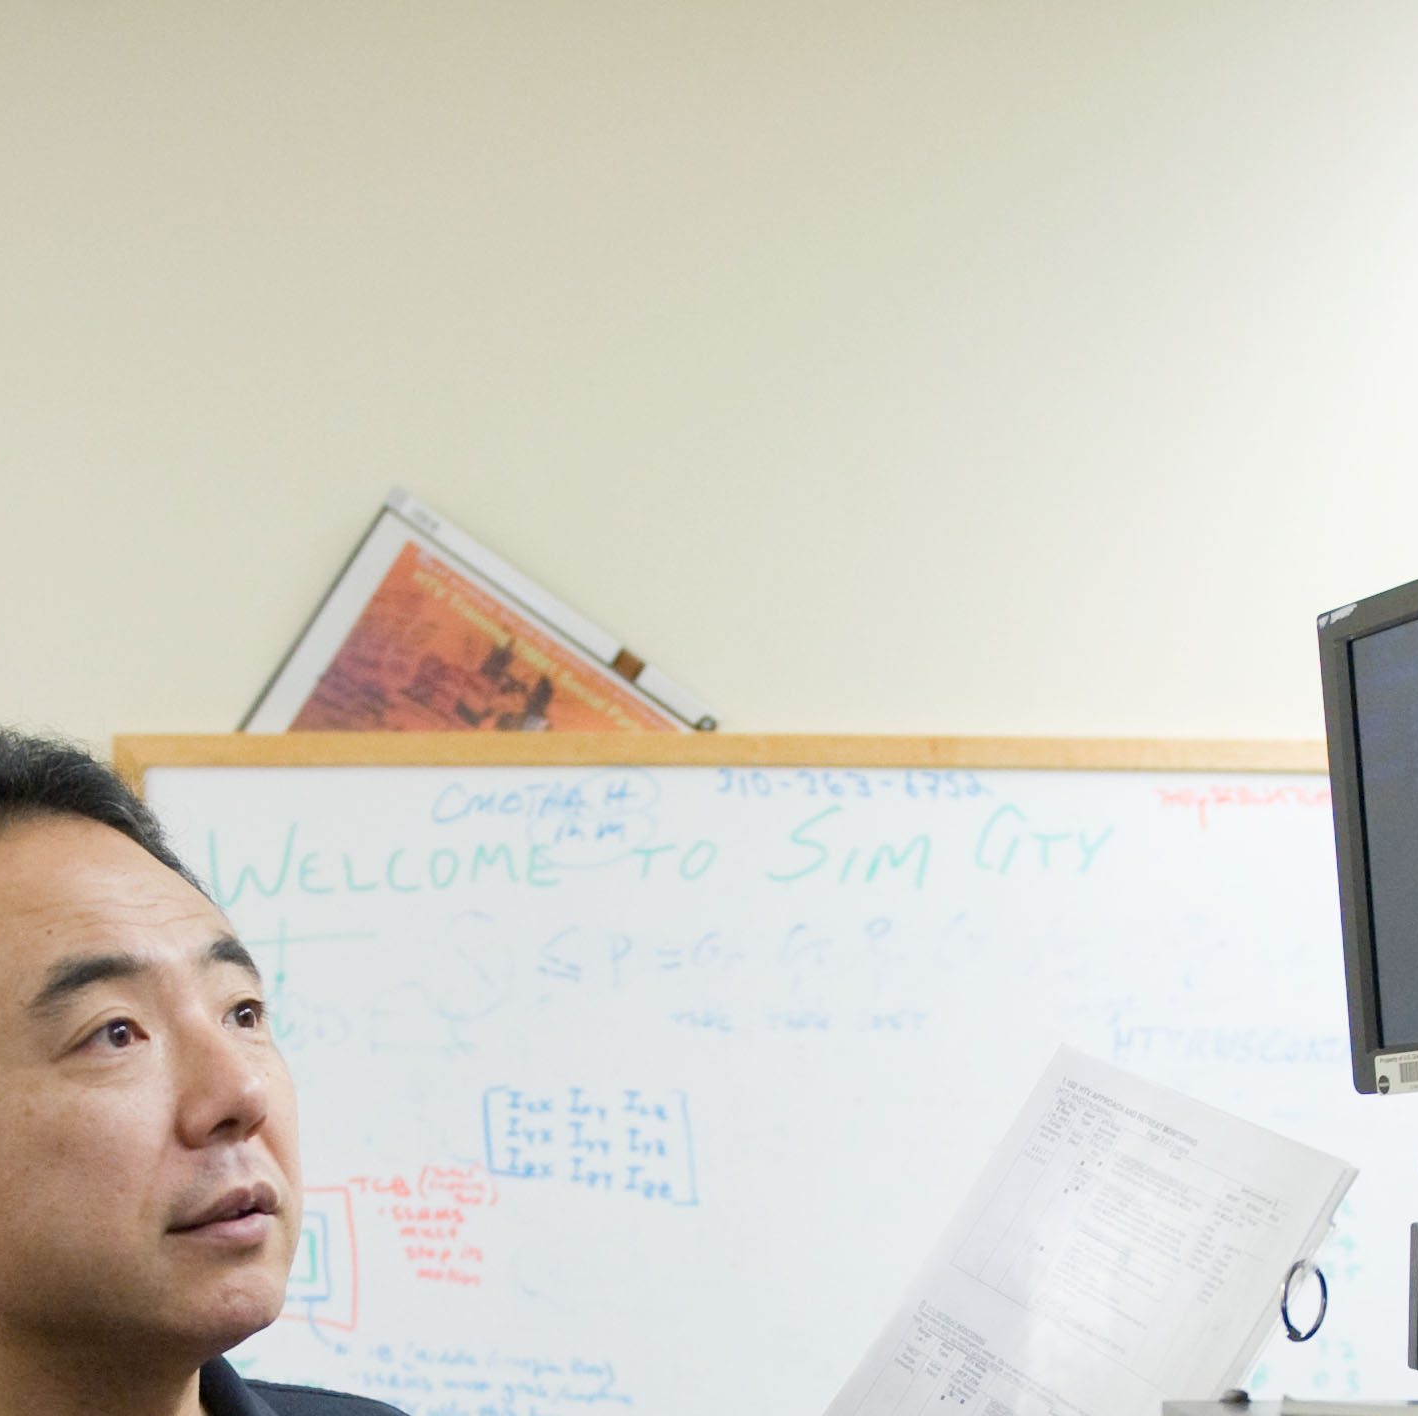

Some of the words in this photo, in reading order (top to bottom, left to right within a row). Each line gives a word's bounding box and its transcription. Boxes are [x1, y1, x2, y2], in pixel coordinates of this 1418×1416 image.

[208, 823, 563, 906] WELCOME
[631, 841, 717, 881] TO
[765, 804, 931, 889] SIM
[975, 803, 1115, 875] CITY
